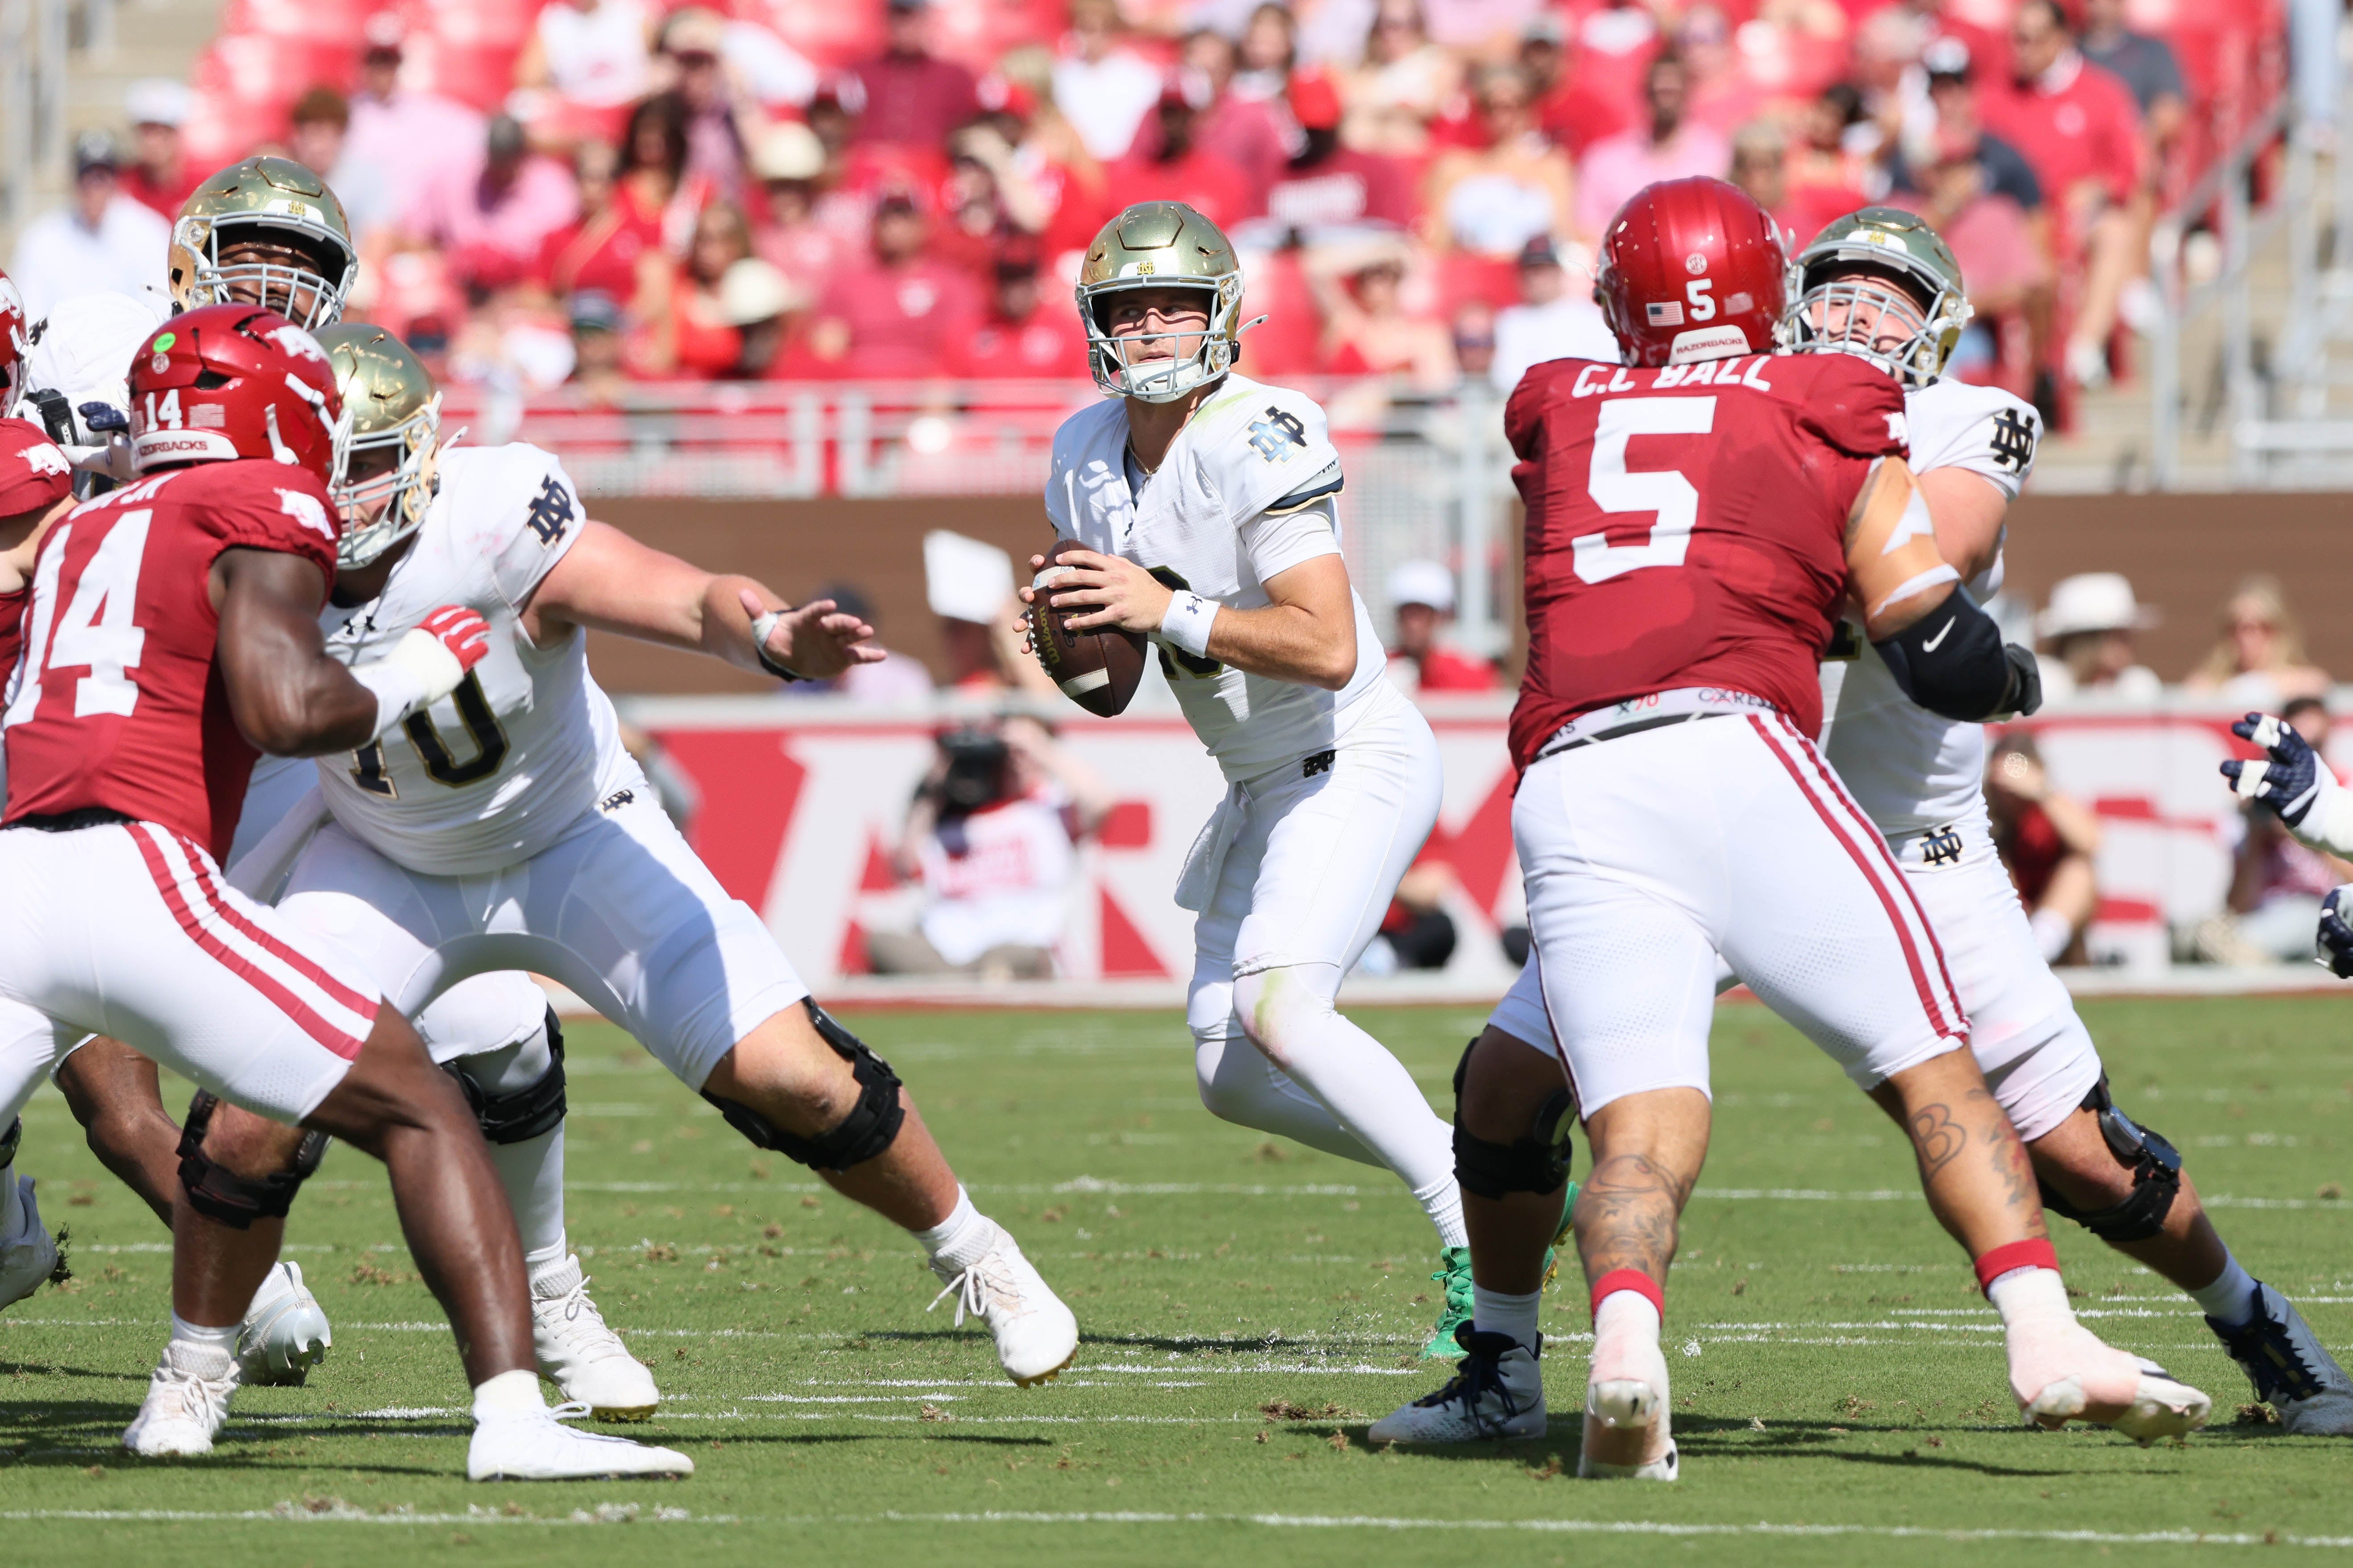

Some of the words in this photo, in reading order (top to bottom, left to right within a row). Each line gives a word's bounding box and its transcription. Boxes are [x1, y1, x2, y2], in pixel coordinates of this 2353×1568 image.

[1686, 278, 1716, 321] 5
[1676, 337, 1744, 355] RAZORBACKS
[1651, 355, 1772, 392] BALL
[145, 389, 183, 433] 14
[1571, 396, 1717, 585] 5
[2, 509, 153, 730] 14
[1038, 605, 1061, 664] Wilson
